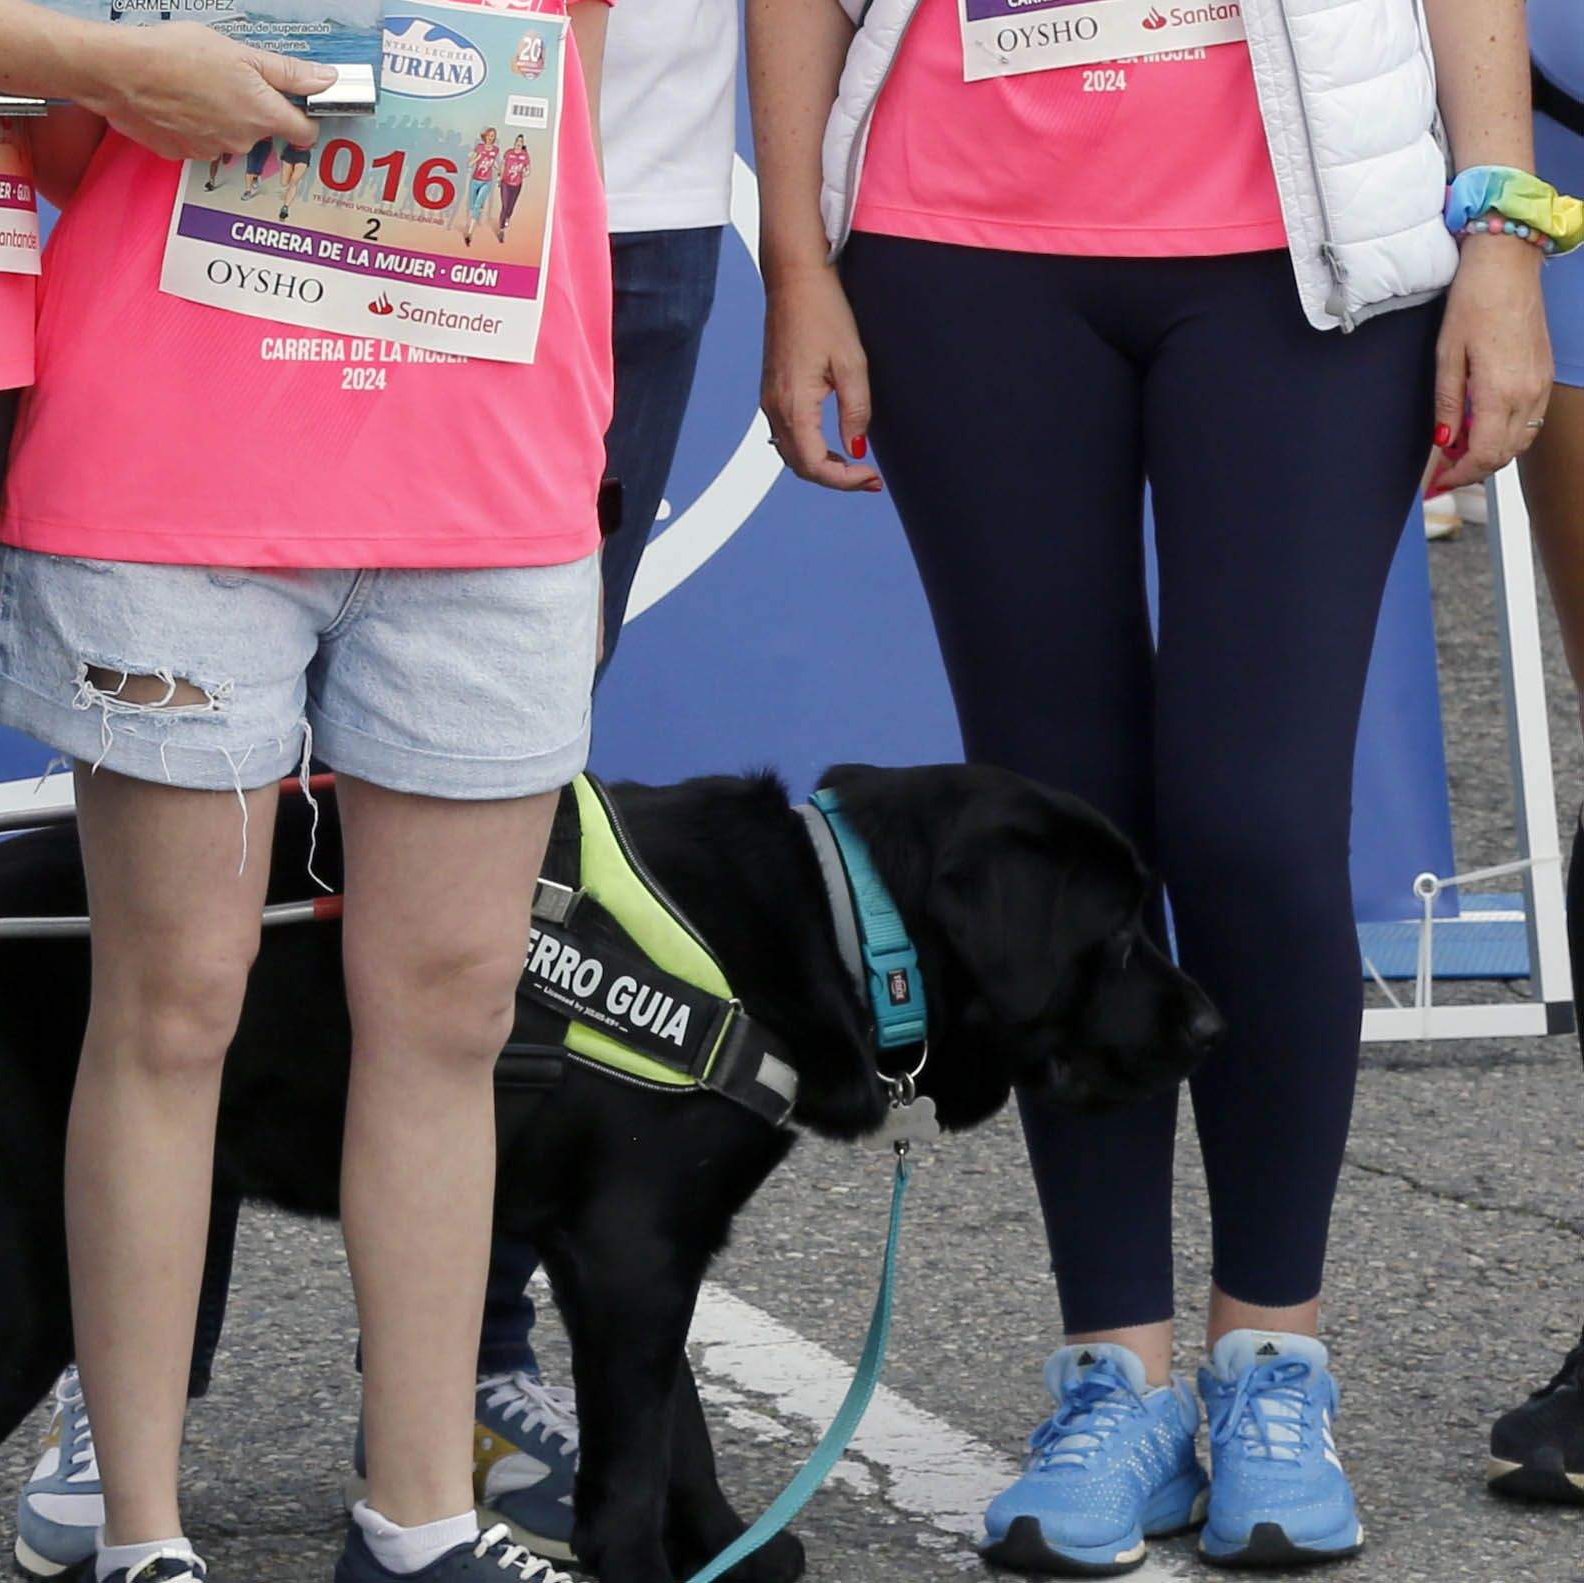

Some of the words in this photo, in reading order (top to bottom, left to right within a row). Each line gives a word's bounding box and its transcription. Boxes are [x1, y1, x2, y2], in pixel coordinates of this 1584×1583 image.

[1170, 2, 1241, 28] Santan
[256, 23, 269, 33] de
[272, 23, 330, 34] superación
[997, 16, 1099, 53] OYSHO
[264, 40, 308, 52] mujeres.
[385, 39, 420, 54] NTRAL
[519, 36, 542, 63] 20
[382, 52, 474, 85] TURIANA
[1082, 70, 1127, 93] 2024
[318, 138, 459, 210] 016
[363, 218, 381, 241] 2
[231, 222, 312, 255] CARRERA
[318, 238, 342, 261] DE
[346, 242, 370, 267] LA
[374, 252, 435, 278] MUJER
[450, 263, 498, 287] GIJÓN
[207, 259, 324, 304] OYSHO
[397, 302, 503, 334] Santander
[261, 337, 346, 362] CARRERA
[350, 339, 374, 362] DE
[380, 341, 402, 362] LA
[341, 368, 387, 391] 2024
[524, 927, 604, 998] ERRO
[606, 975, 691, 1047] GUIA
